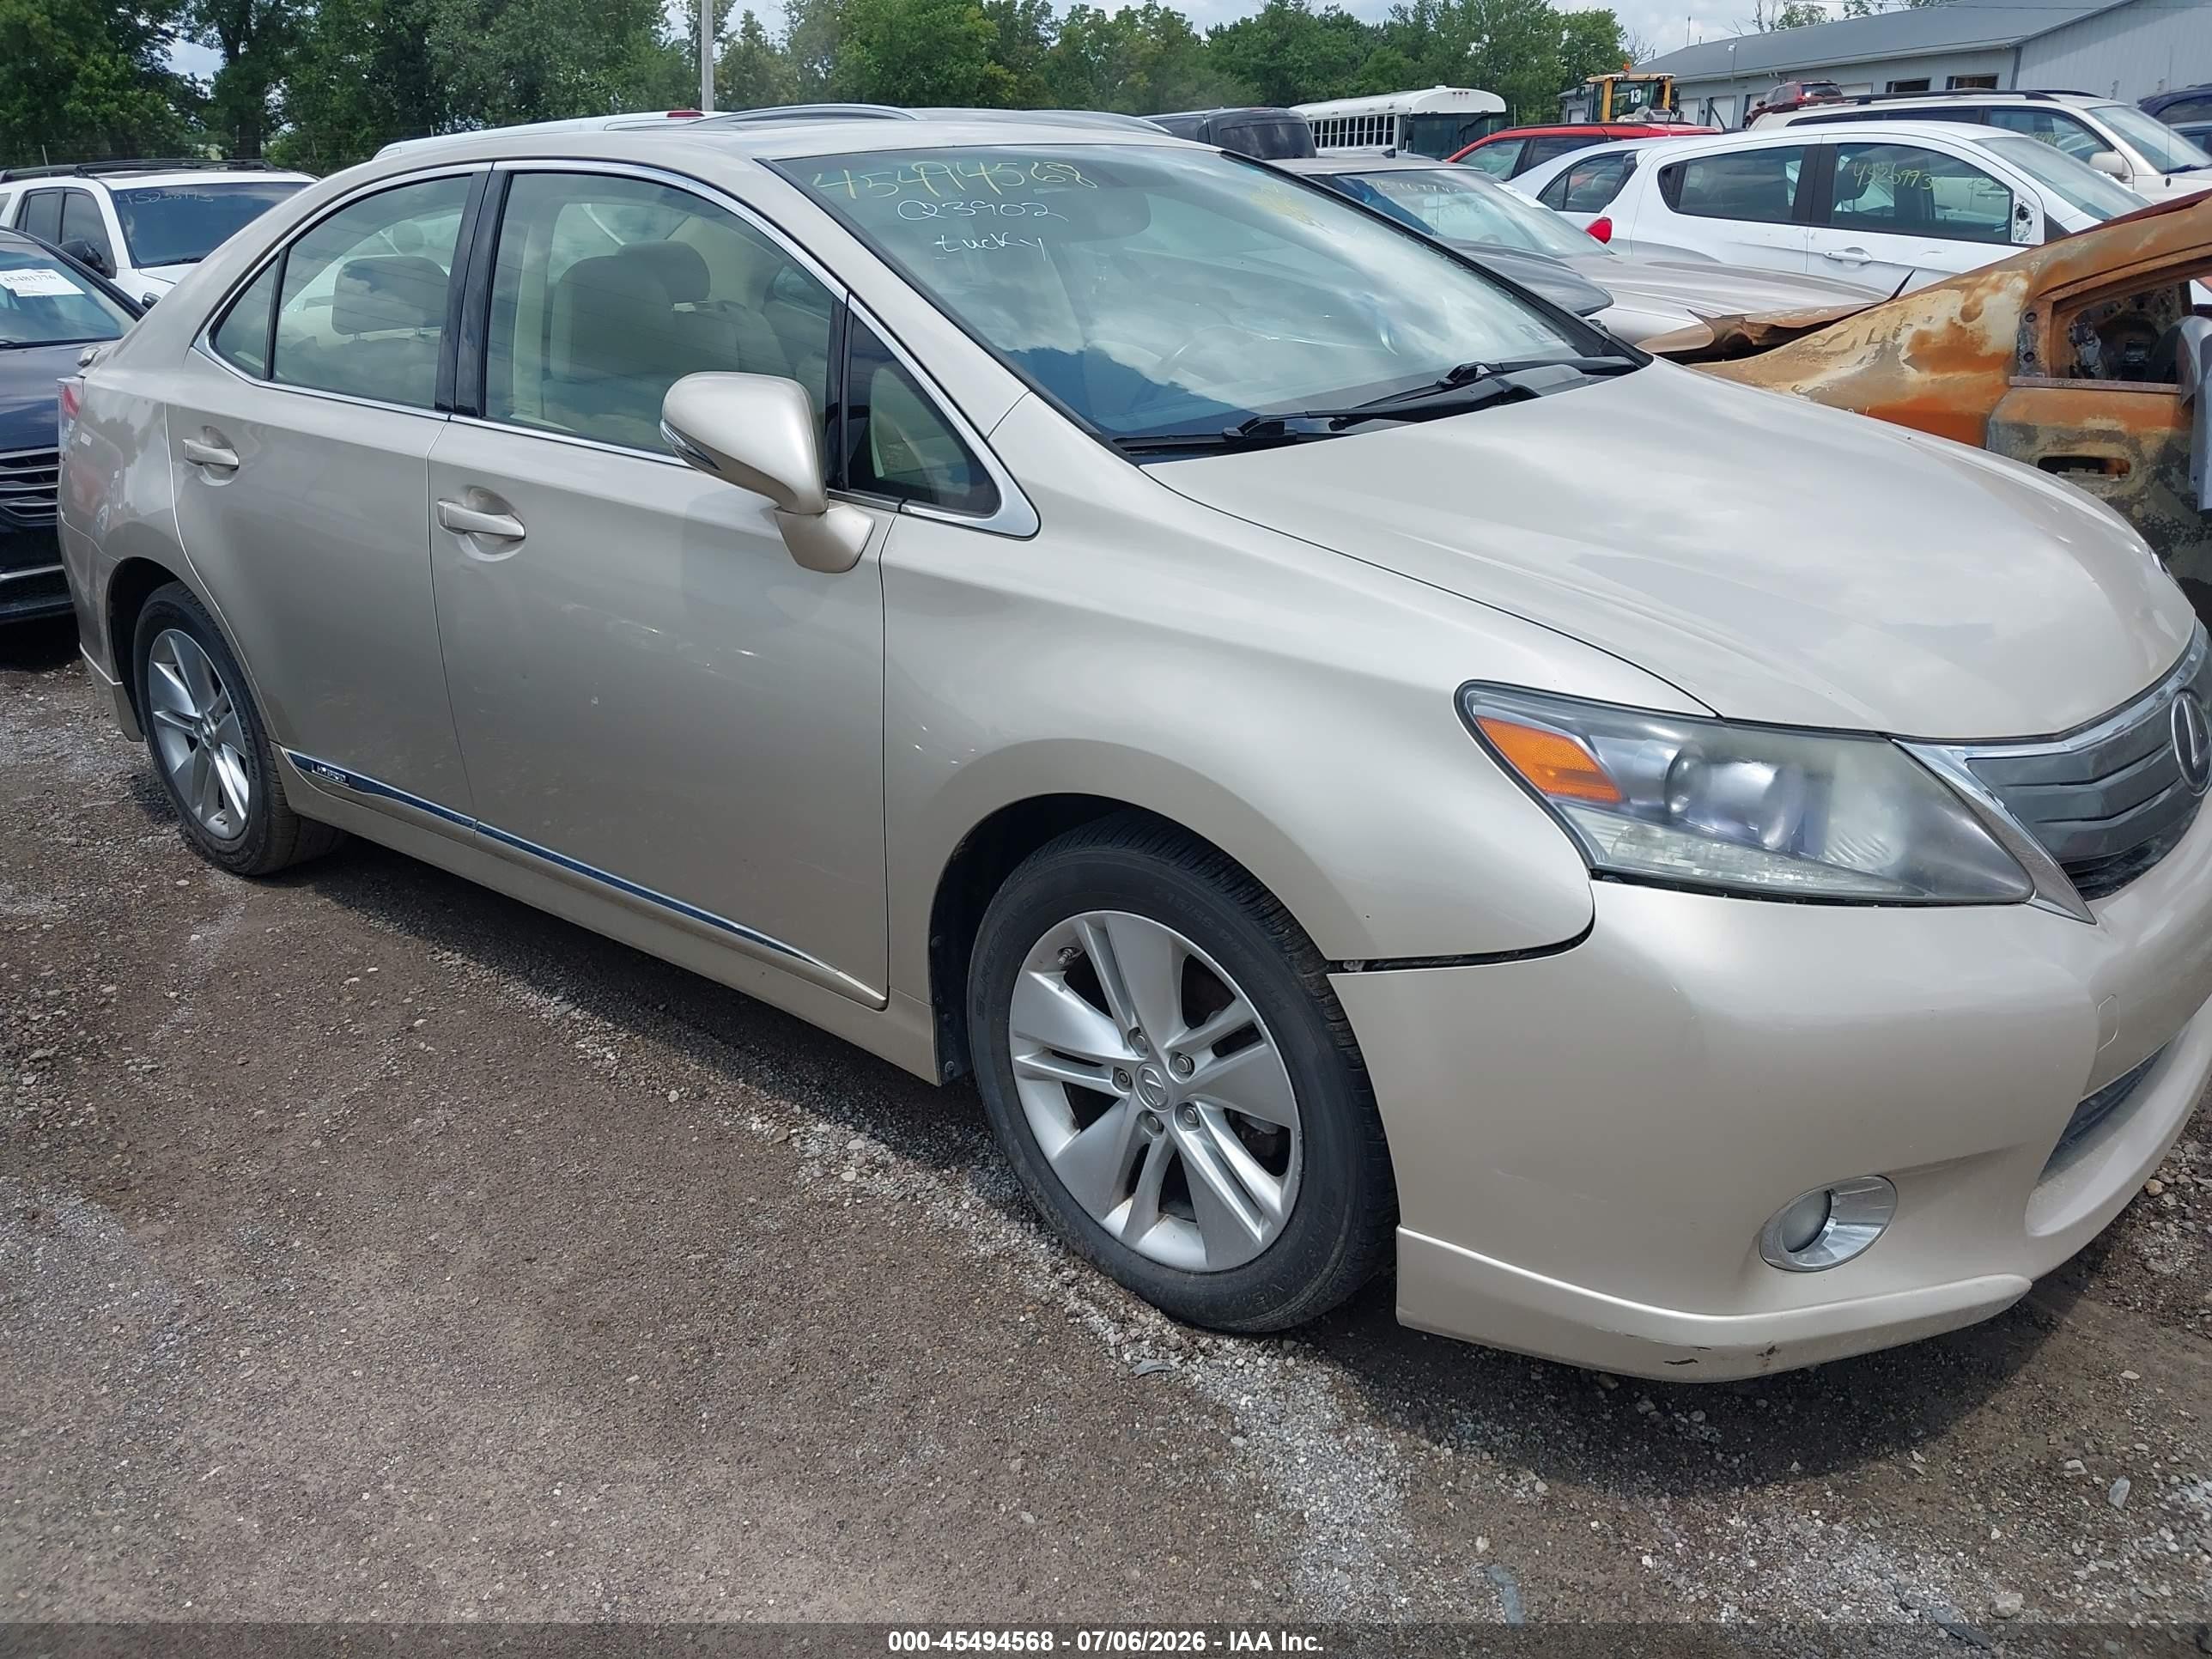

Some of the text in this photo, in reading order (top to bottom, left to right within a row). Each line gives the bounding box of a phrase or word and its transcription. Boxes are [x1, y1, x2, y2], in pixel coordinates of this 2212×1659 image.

[1630, 88, 1642, 104] 13
[811, 161, 1098, 199] 45494568
[896, 200, 1069, 222] Q3902
